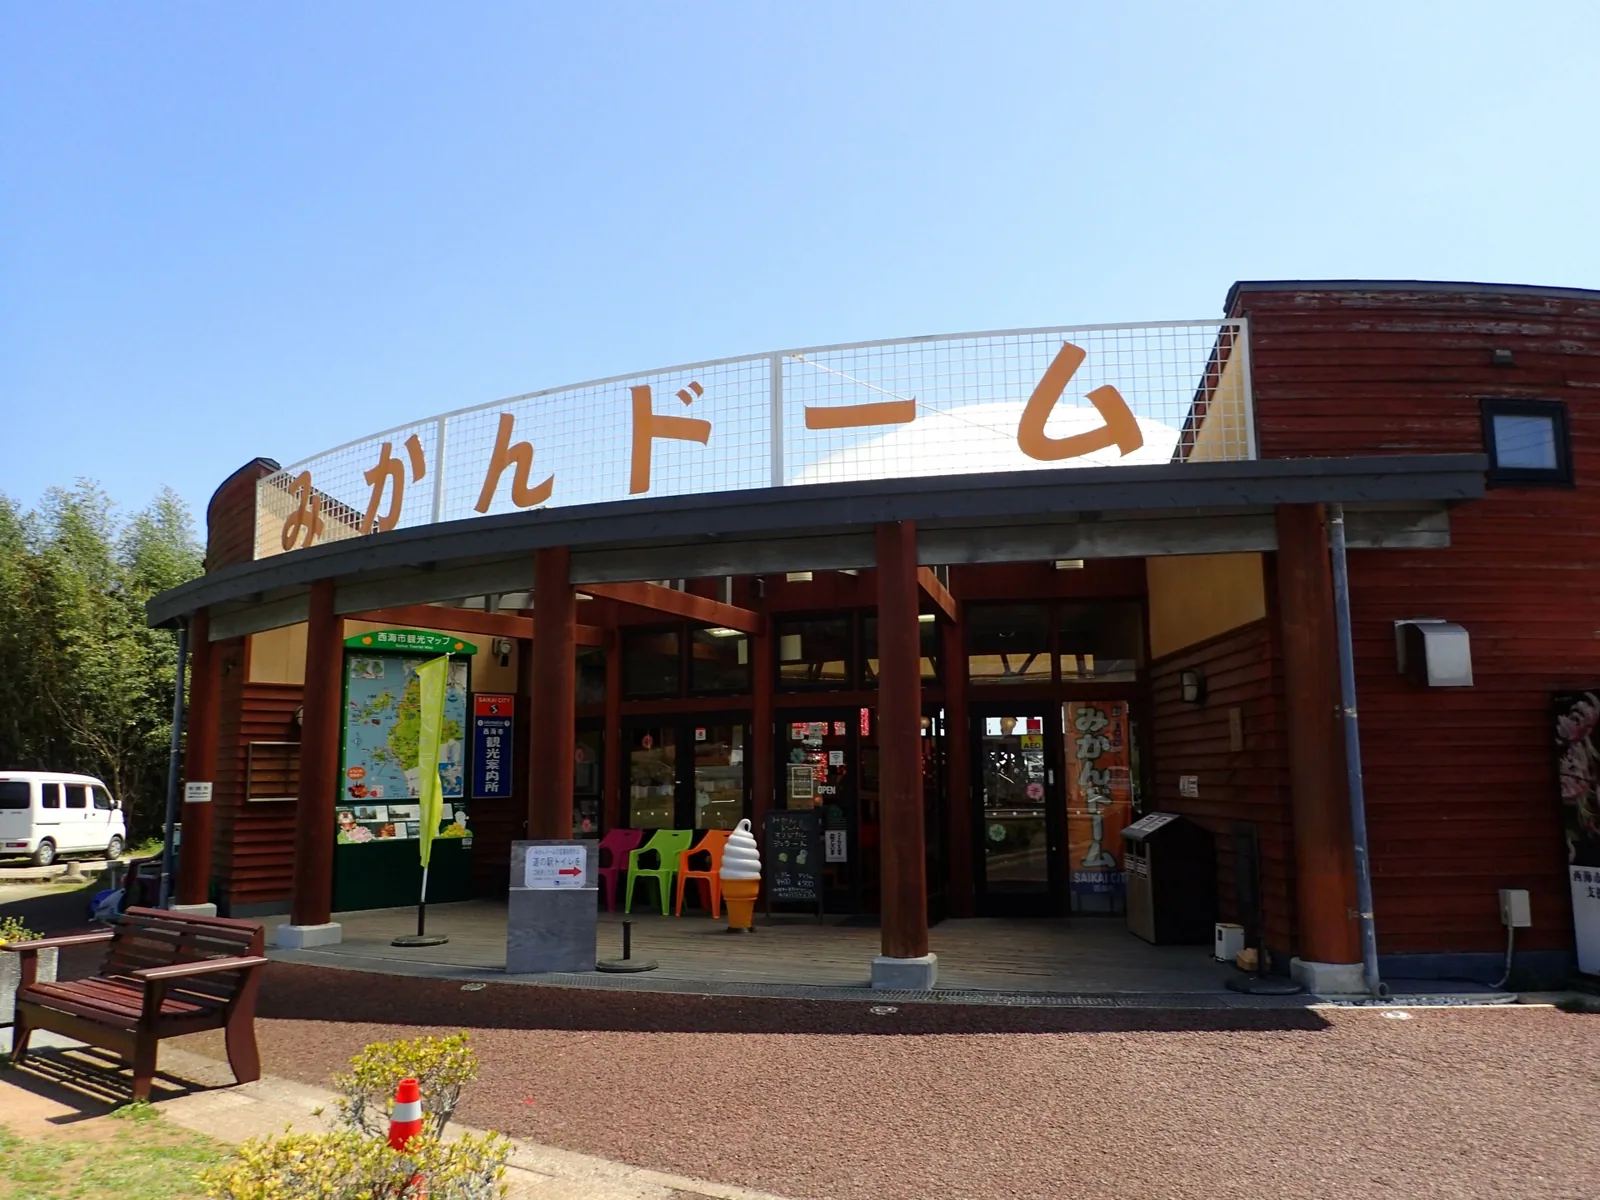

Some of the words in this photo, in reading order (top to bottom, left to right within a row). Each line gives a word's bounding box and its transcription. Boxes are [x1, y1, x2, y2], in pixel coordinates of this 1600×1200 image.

[282, 341, 1144, 551] みかんドーム
[377, 632, 450, 645] 西海市観光マップ
[484, 736, 500, 792] 観光案内所
[817, 786, 836, 795] OPEN
[1075, 707, 1117, 868] みかんドーム
[532, 857, 580, 867] 道の駅トイレを
[1074, 872, 1109, 883] SAIKAI
[1110, 872, 1126, 884] CIT
